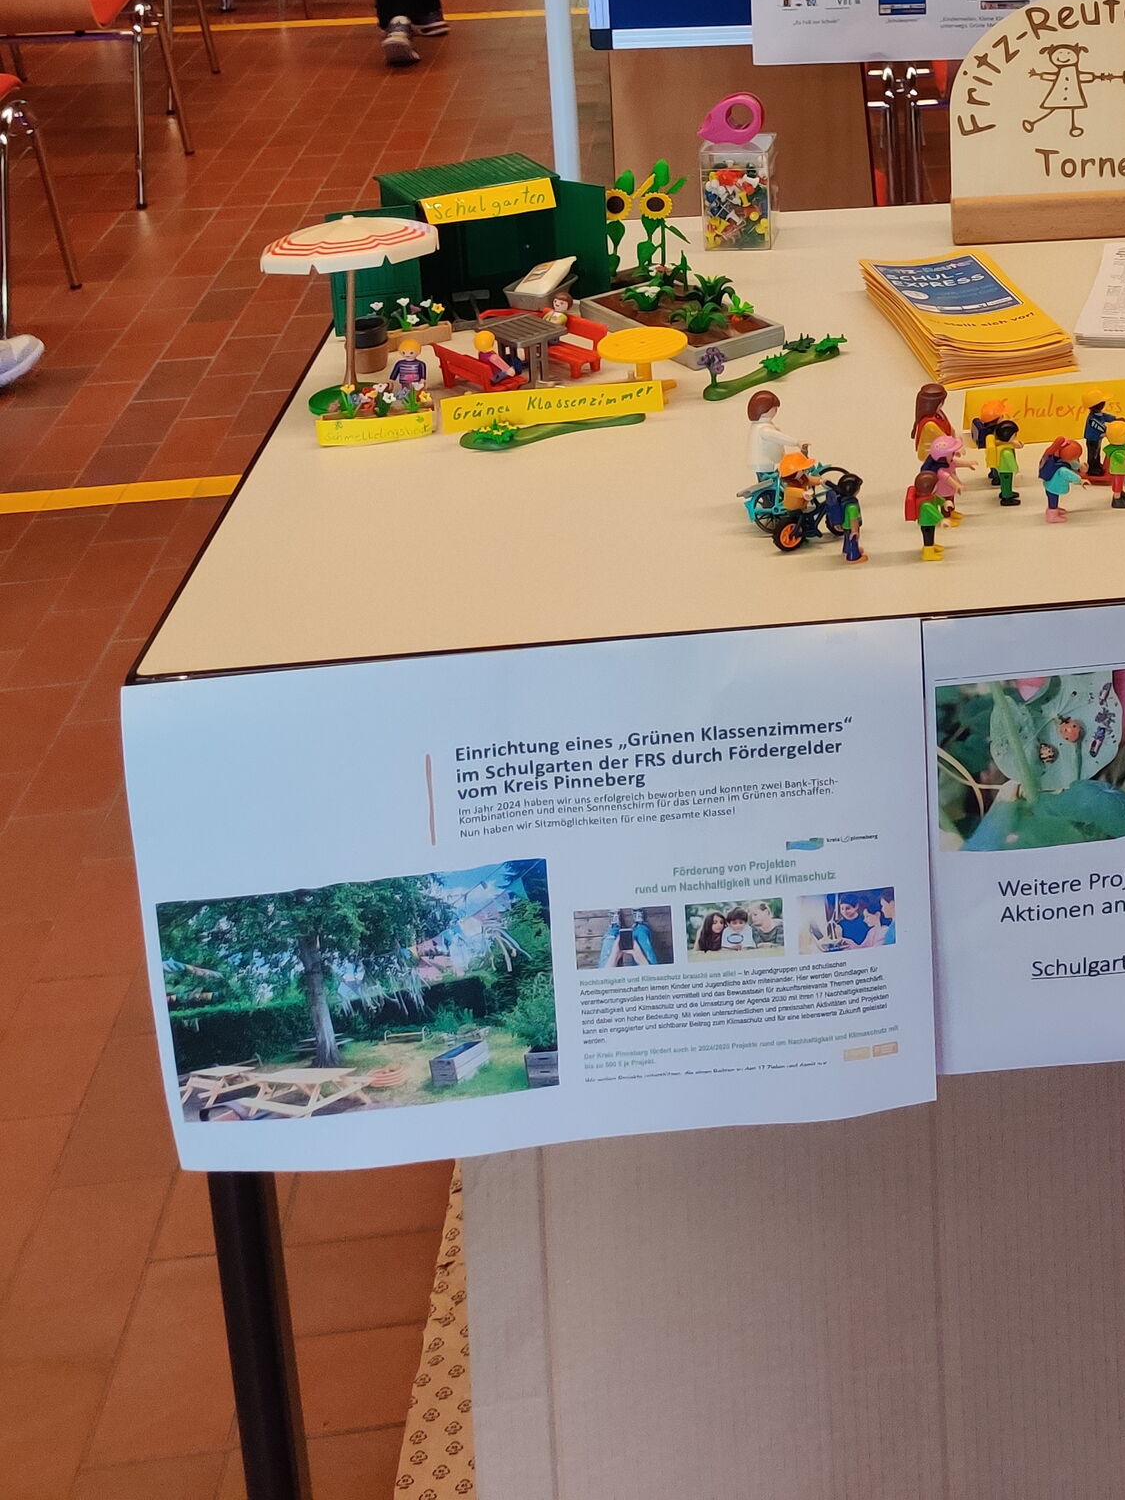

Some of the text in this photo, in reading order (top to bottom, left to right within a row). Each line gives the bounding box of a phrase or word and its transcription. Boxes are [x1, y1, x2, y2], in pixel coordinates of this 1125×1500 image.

[433, 187, 545, 220] Schulgarten
[528, 385, 653, 411] Klassenzimmer
[455, 717, 852, 762] Einrichtung eines „Grünen Klassenzimmers“
[456, 740, 842, 783] im Schulgarten der FRS durch Fördergelder
[457, 773, 646, 800] vom Kreis Pinneberg
[460, 806, 736, 838] Nun haben wir Sitzmöglichkeiten für eine gesamte Klasse!
[673, 860, 796, 876] Förderung von Projekten
[635, 871, 836, 895] rund um Nachhaltigkeit und Klimaschutz
[998, 878, 1082, 897] Weitere
[1000, 904, 1094, 922] Aktionen
[1101, 901, 1125, 915] an
